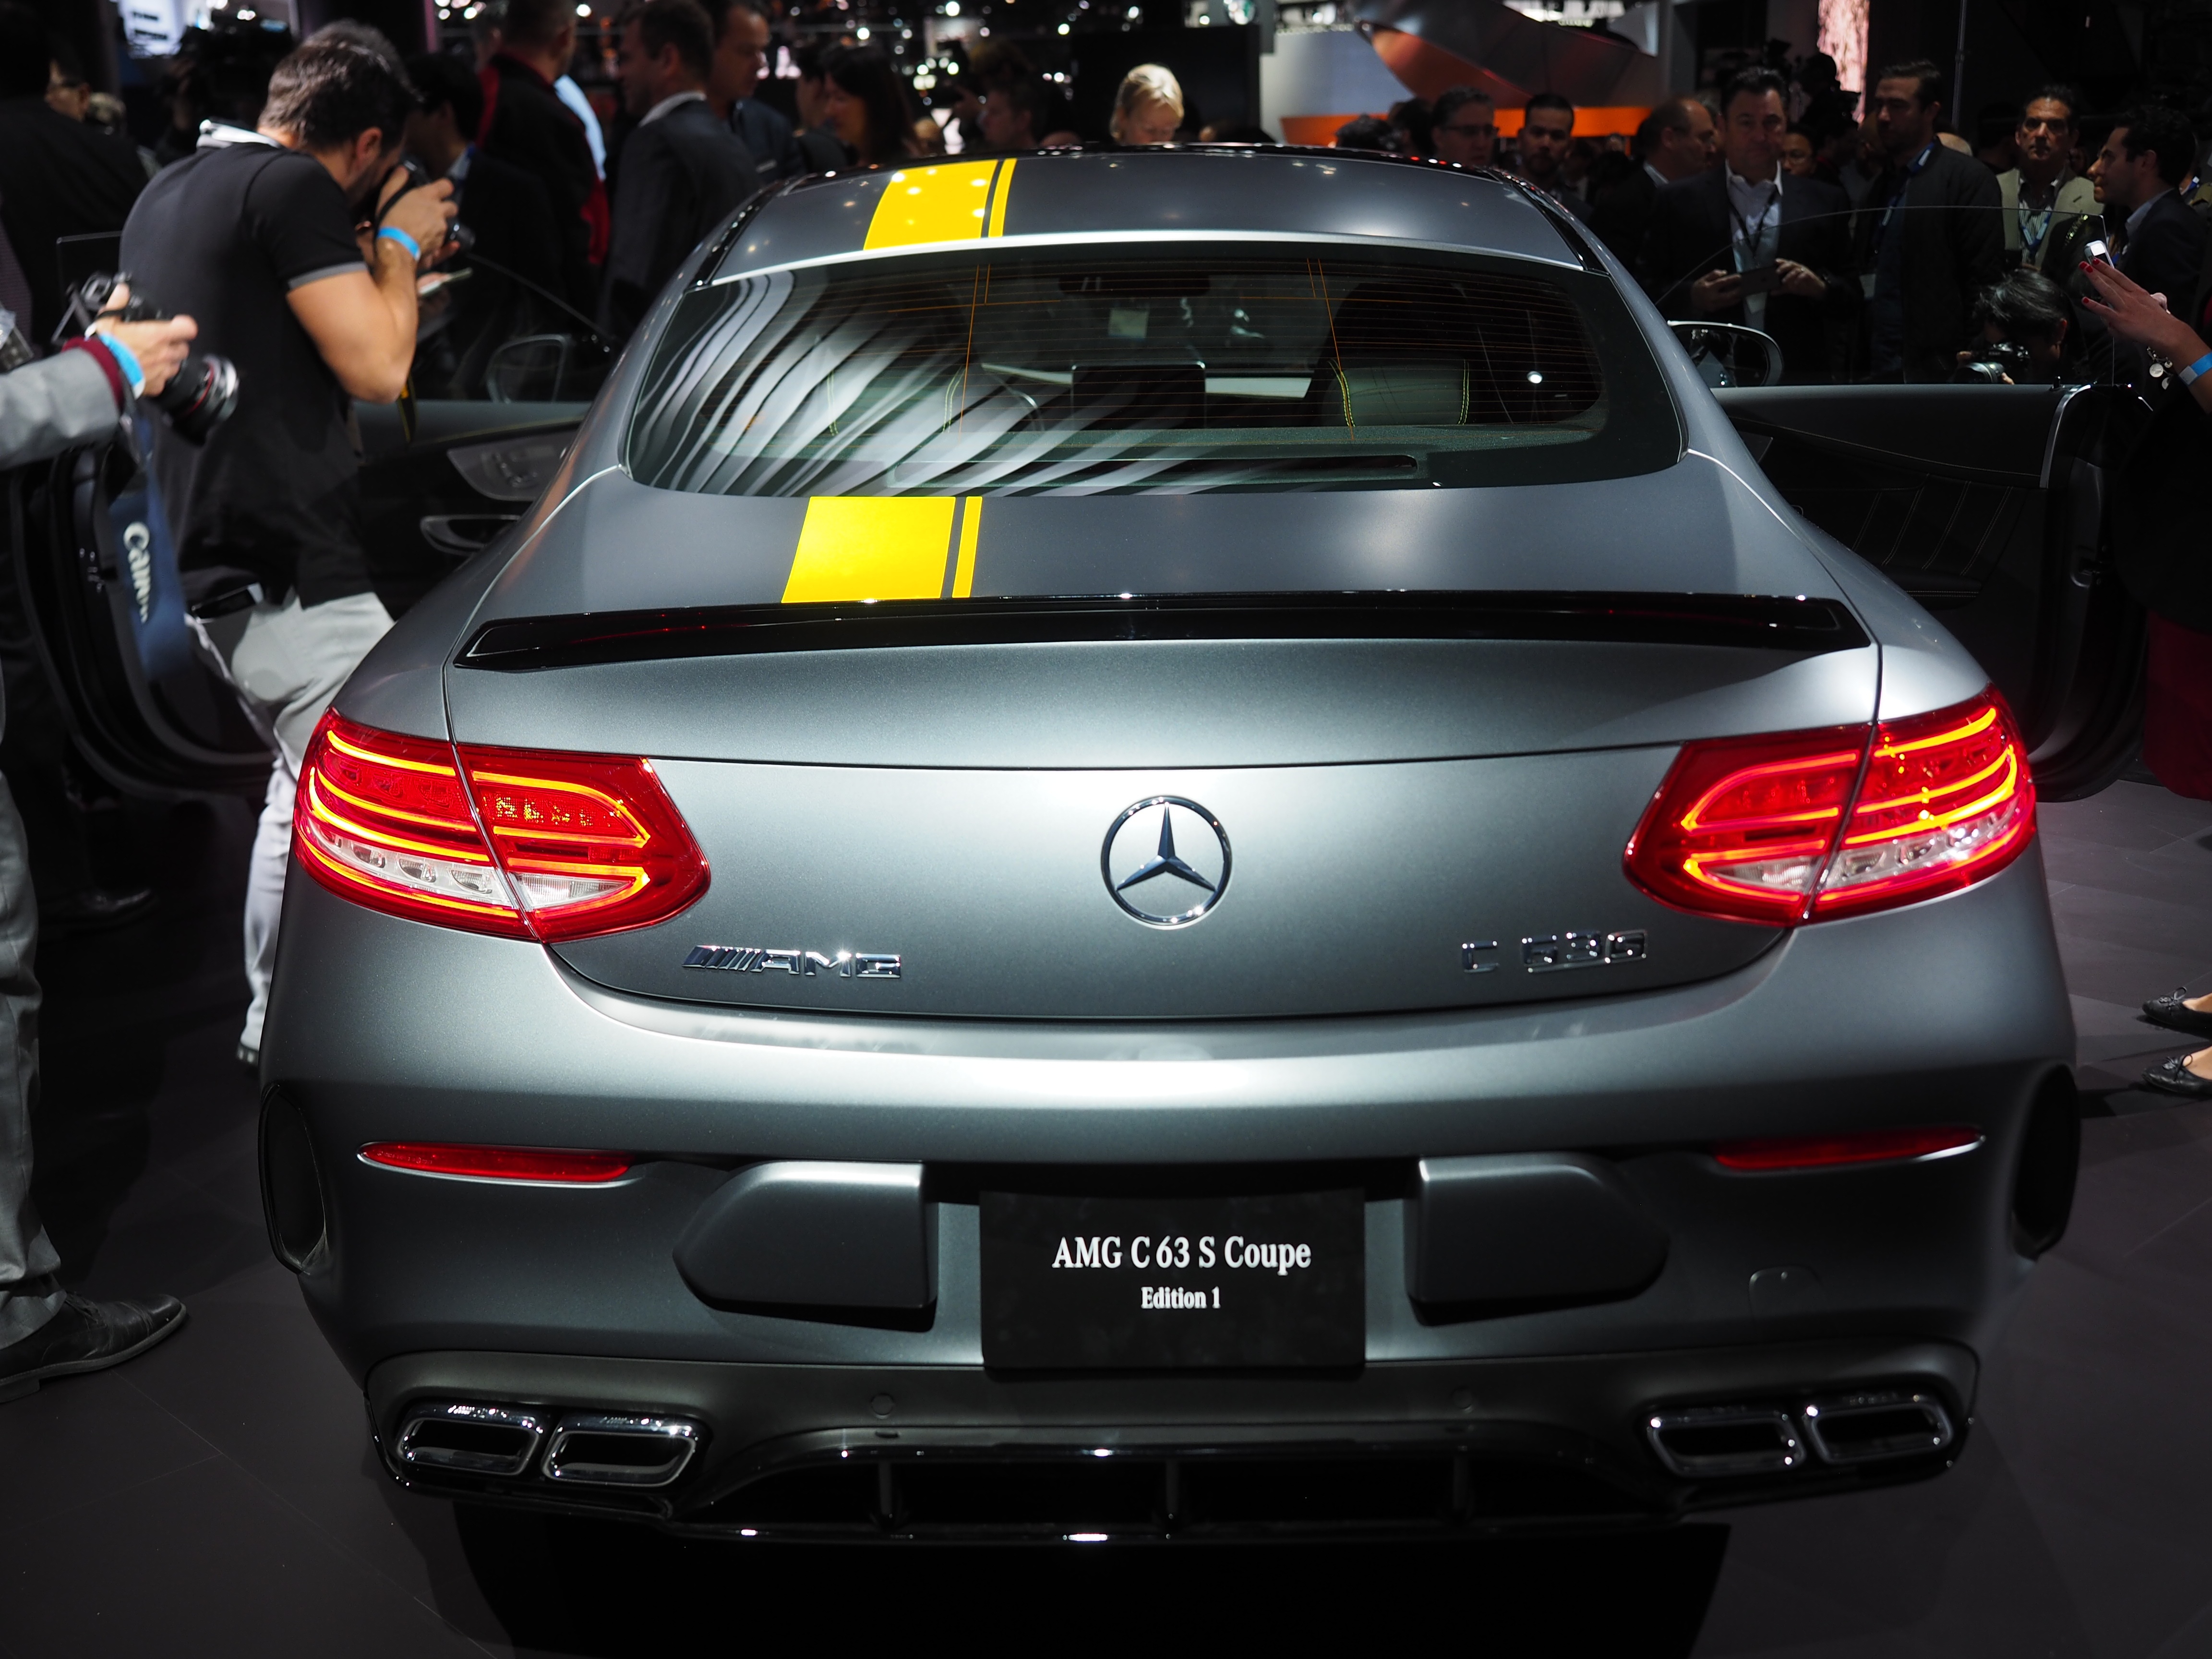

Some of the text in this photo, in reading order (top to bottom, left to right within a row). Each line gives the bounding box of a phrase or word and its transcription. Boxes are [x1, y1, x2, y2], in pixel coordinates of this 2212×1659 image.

[1052, 1236, 1311, 1276] AMG C 63 S Coupe
[1141, 1286, 1220, 1309] Edition 1
